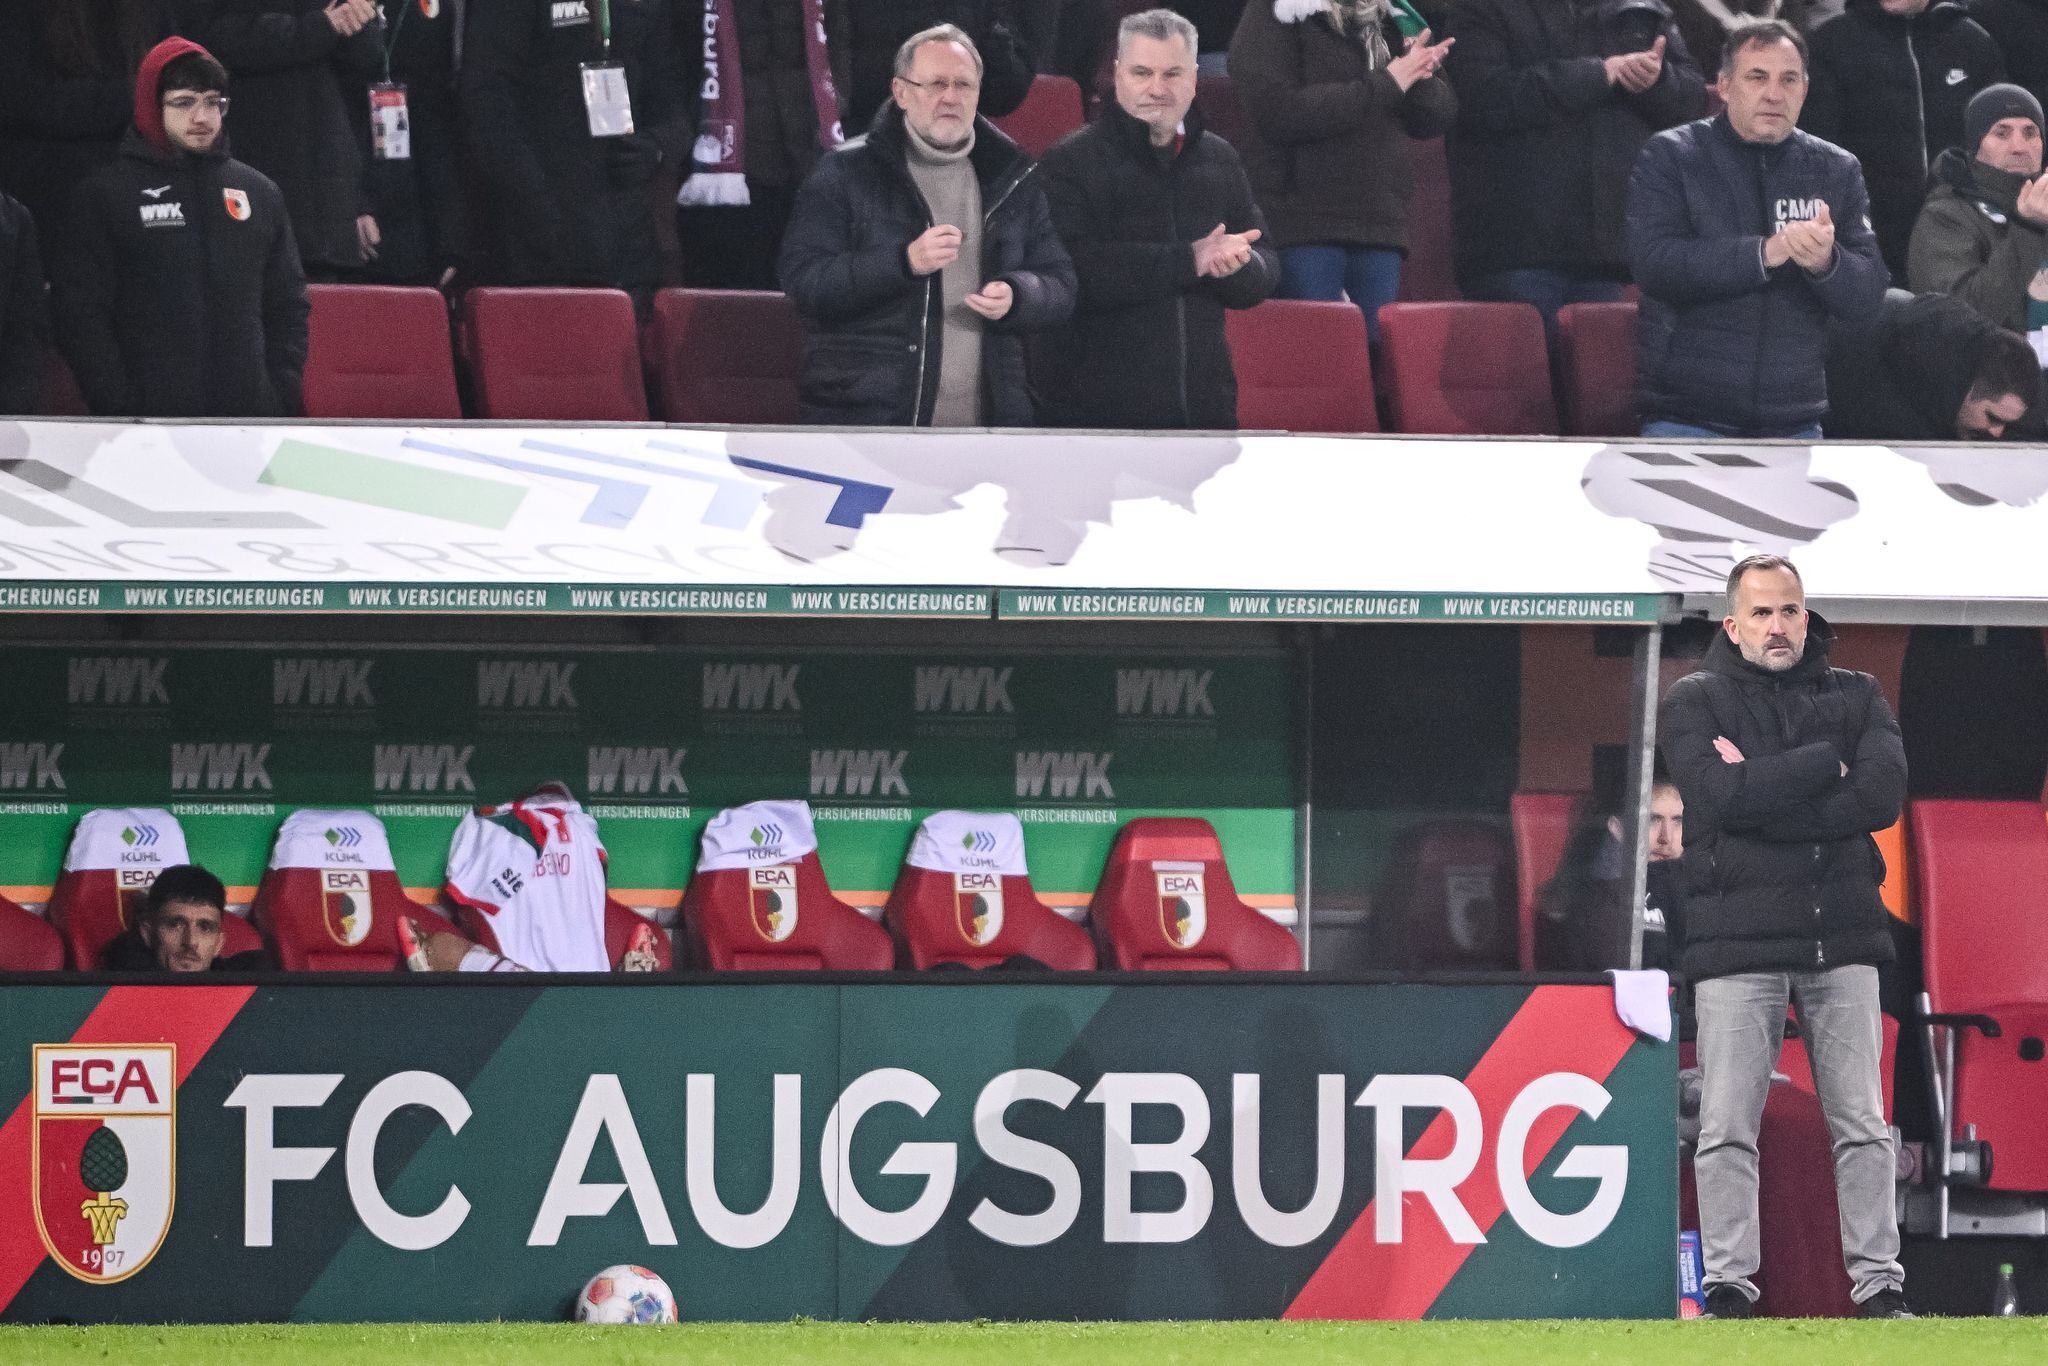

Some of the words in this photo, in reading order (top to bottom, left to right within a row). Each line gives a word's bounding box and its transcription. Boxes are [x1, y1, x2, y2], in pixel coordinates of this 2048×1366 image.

[140, 202, 184, 221] WWK
[125, 588, 167, 606] WWK
[174, 588, 324, 606] VERSICHERUNGEN
[348, 588, 392, 606] WWK
[397, 589, 547, 607] VERSICHERUNGEN
[571, 590, 613, 607] WWK
[619, 590, 767, 609] VERSICHERUNGEN
[791, 592, 833, 610] WWK
[838, 592, 987, 611] VERSICHERUNGEN
[1017, 595, 1057, 613] WWK
[1062, 595, 1205, 613] VERSICHERUNGEN
[1229, 597, 1270, 615] WWK
[1276, 597, 1420, 615] VERSICHERUNGEN
[1443, 598, 1484, 616] WWK
[1490, 599, 1634, 617] VERSICHERUNGEN
[68, 657, 169, 704] WWK
[273, 659, 374, 704] WWK
[478, 660, 578, 707] WWK
[703, 663, 800, 710] WWK
[915, 666, 1015, 713] WWK
[1116, 668, 1215, 715] WWK
[0, 743, 67, 788] WK
[171, 743, 273, 789] WWK
[374, 744, 476, 790] WWK
[587, 747, 689, 793] WWK
[810, 750, 910, 796] WWK
[1015, 752, 1115, 798] WWK
[811, 808, 912, 821] VERSICHERUNGEN
[1017, 810, 1117, 823] VERSICHERUNGEN
[122, 870, 157, 885] FCA
[328, 873, 363, 888] FCA
[755, 870, 790, 885] FCA
[961, 874, 997, 888] FCA
[1164, 877, 1199, 892] FCA
[52, 1059, 160, 1104] FCA
[223, 1070, 471, 1251] FC
[527, 1067, 1629, 1248] AUGSBURG
[81, 1249, 125, 1269] 1907
